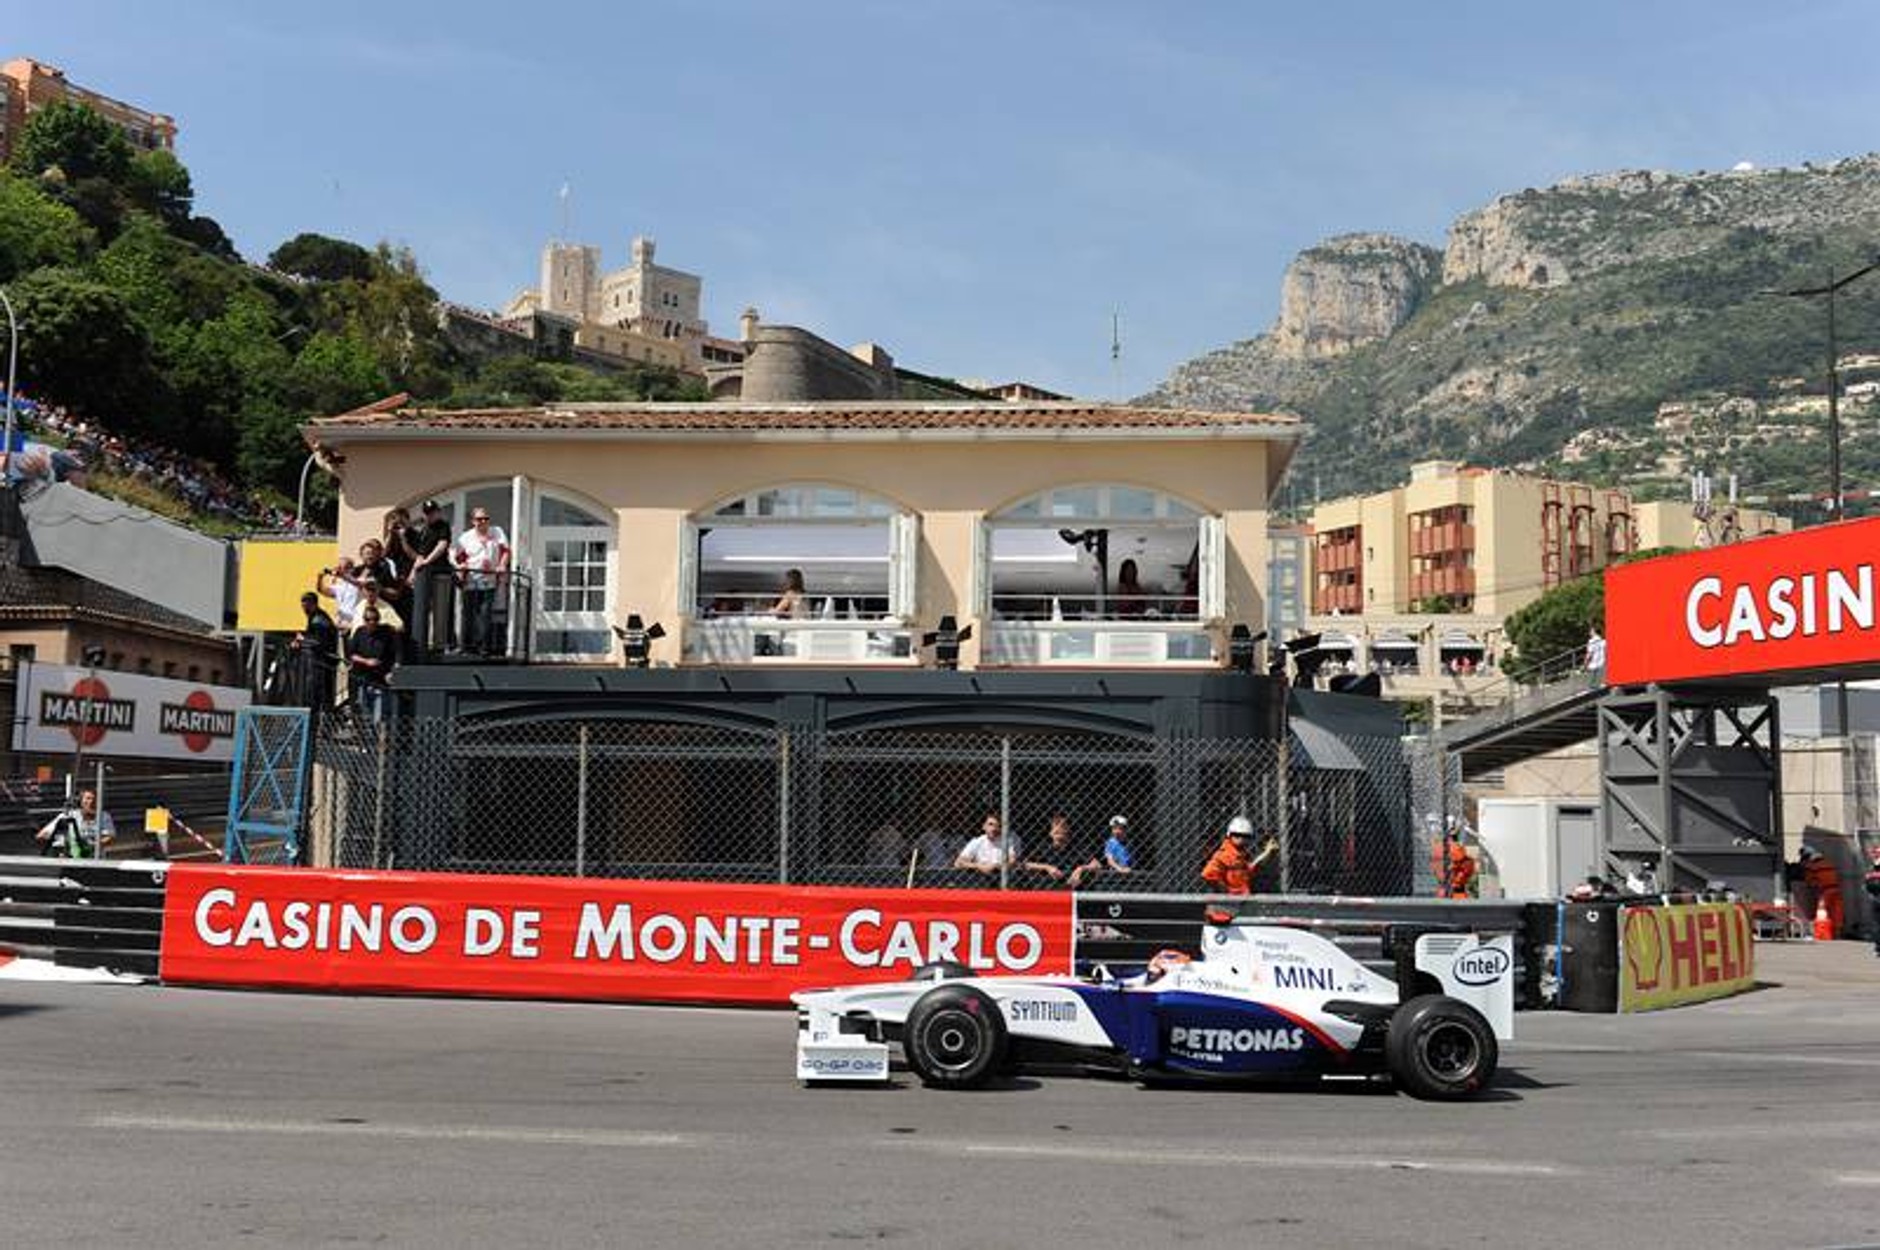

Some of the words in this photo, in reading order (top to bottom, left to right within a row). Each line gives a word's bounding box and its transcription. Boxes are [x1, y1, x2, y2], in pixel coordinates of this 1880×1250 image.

[1686, 564, 1875, 649] CASIN
[45, 698, 131, 726] MARTINI
[163, 710, 233, 733] MARTINI
[194, 888, 438, 954] CASINO
[463, 907, 542, 958] DE
[572, 901, 1043, 971] MONTE-CARLO
[1460, 956, 1501, 975] intel
[1011, 1000, 1077, 1022] SYNTIUM
[1170, 1027, 1304, 1052] PETRONAS
